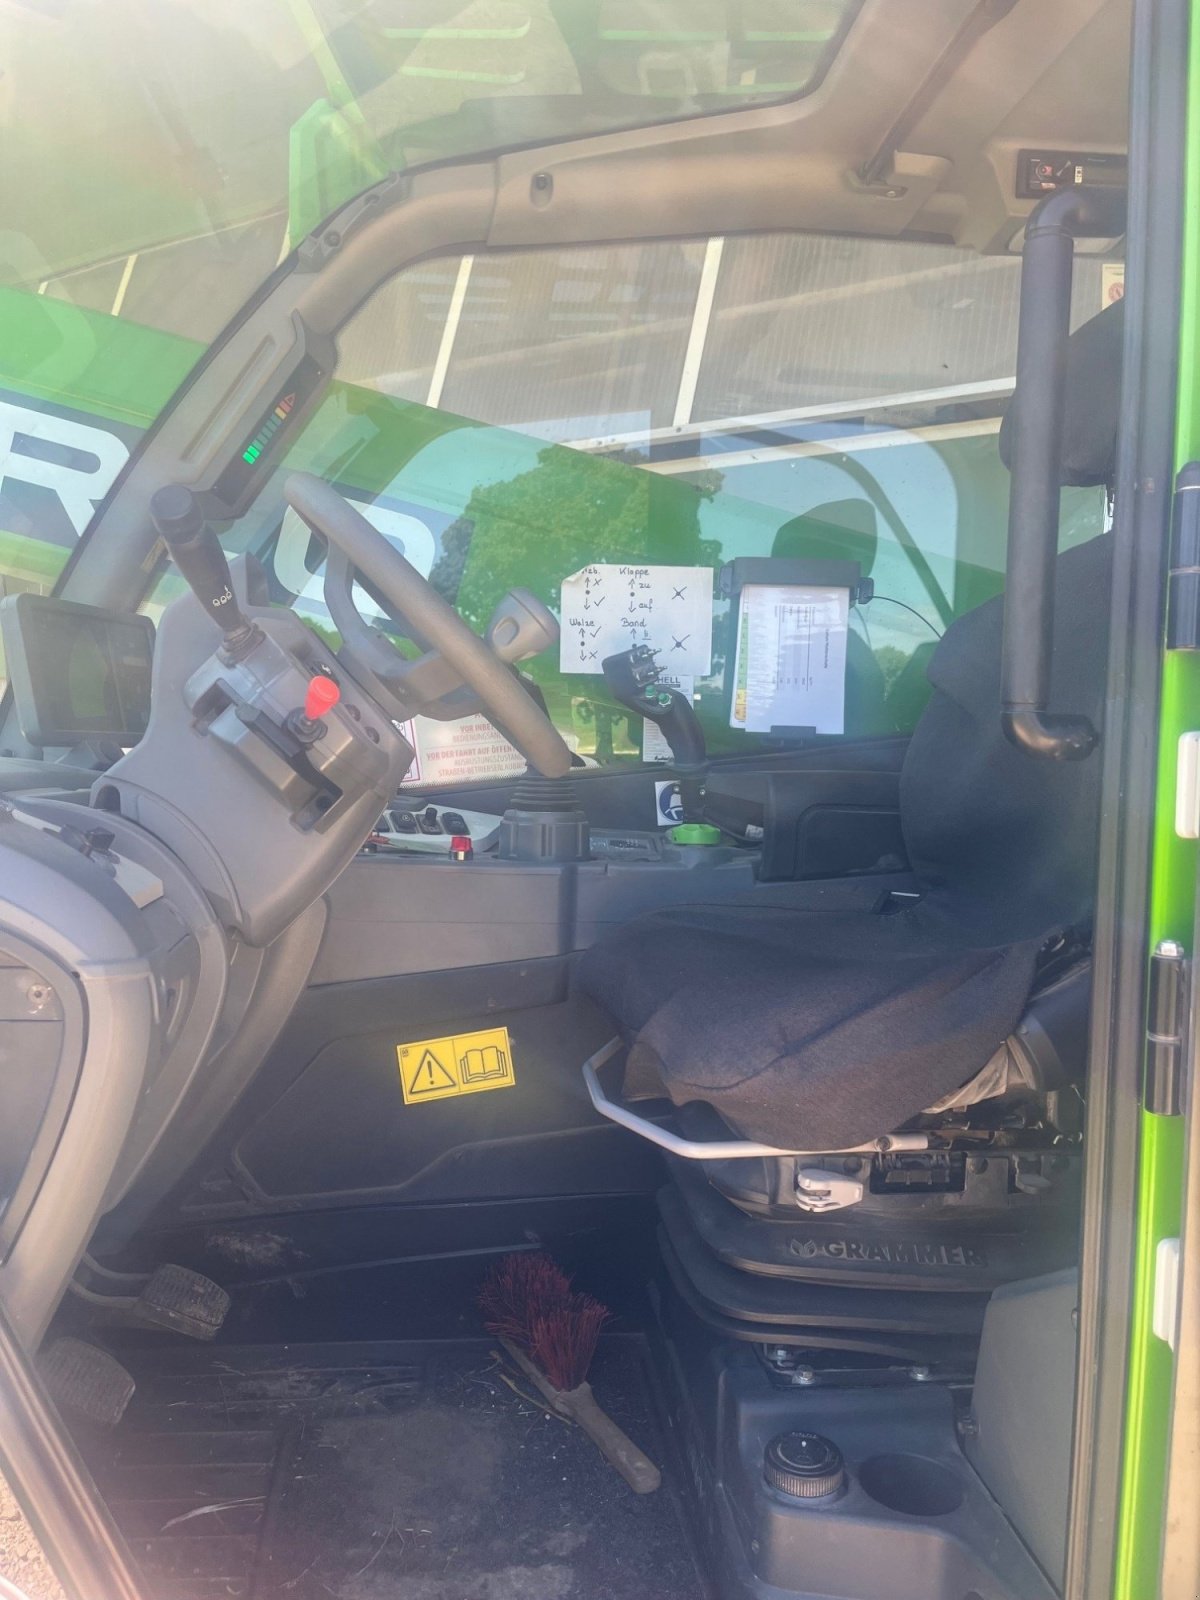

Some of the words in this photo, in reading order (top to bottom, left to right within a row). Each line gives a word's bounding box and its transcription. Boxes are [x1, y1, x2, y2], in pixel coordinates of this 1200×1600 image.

[569, 618, 595, 627] Walze
[620, 617, 647, 628] Band
[823, 1239, 988, 1267] GRAMMER
